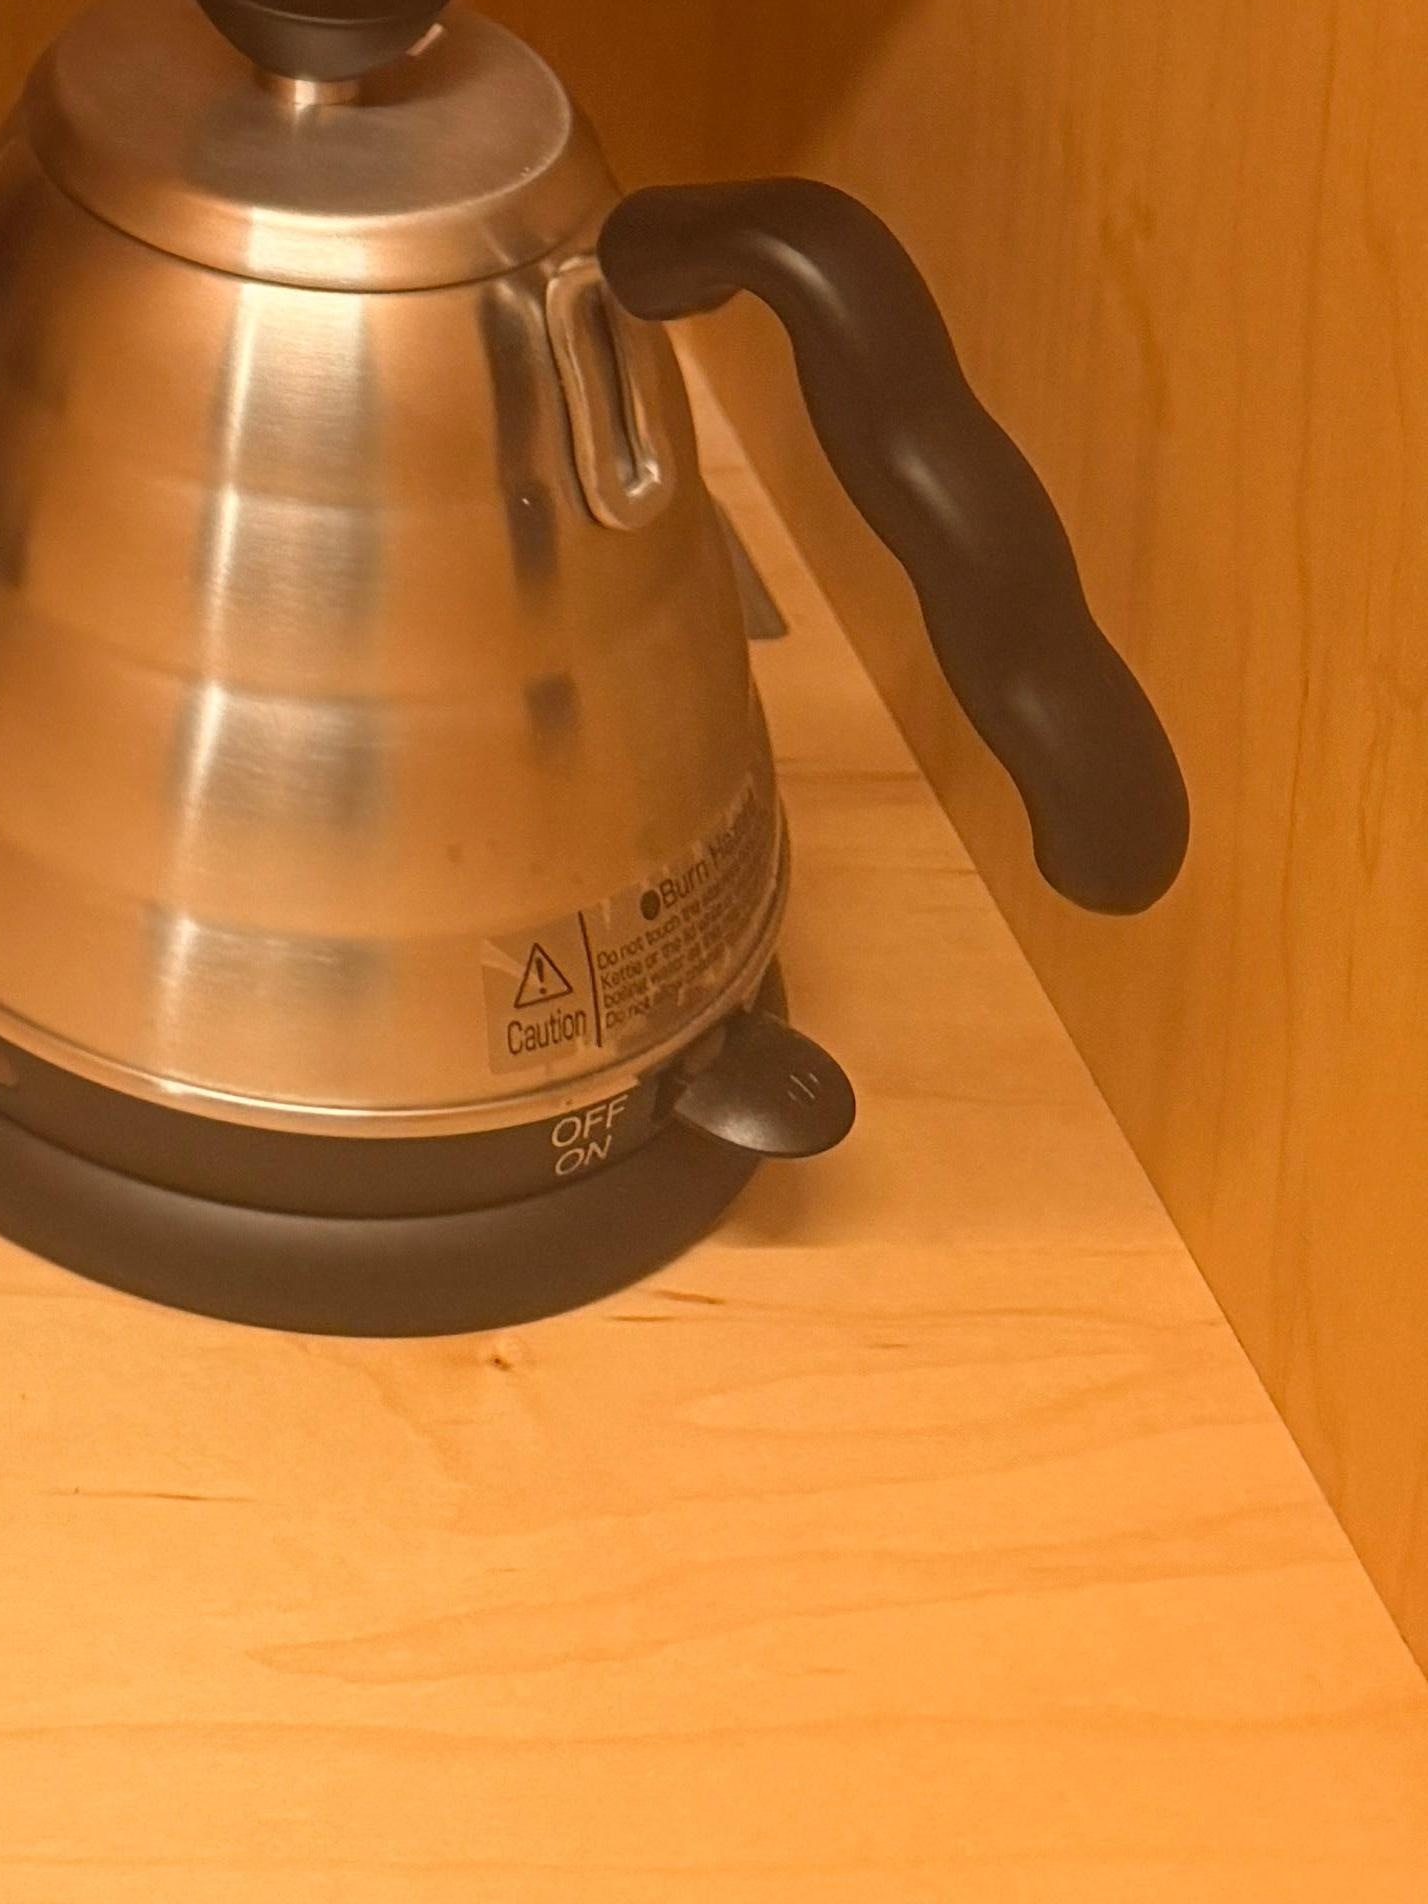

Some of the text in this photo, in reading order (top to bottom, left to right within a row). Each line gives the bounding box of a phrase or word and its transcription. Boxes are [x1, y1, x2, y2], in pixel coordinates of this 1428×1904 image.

[659, 859, 710, 909] Burn
[597, 950, 619, 971] Do
[620, 936, 645, 958] not
[507, 1008, 587, 1055] Caution
[551, 1094, 629, 1147] OFF
[555, 1134, 612, 1175] ON
